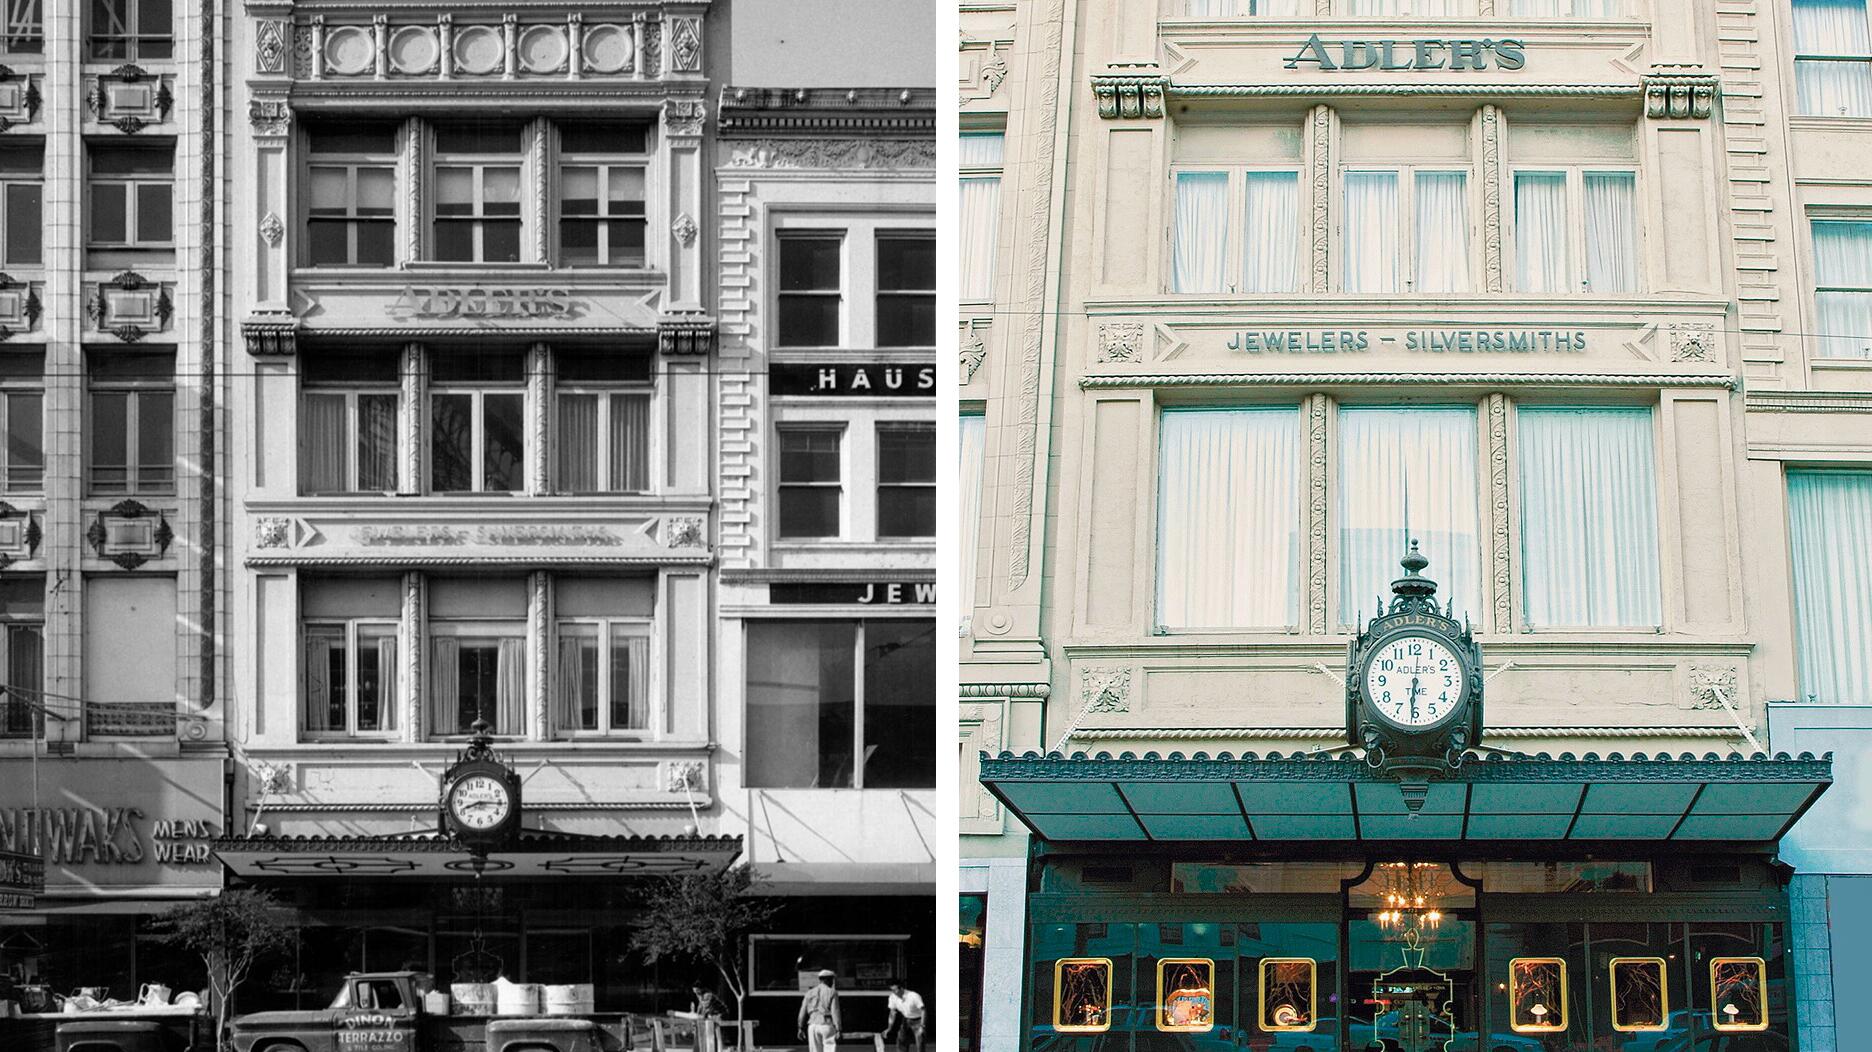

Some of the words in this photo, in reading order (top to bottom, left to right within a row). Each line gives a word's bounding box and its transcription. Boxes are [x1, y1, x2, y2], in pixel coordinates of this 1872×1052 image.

[1283, 32, 1526, 71] ADLER'S
[384, 284, 569, 316] ADLER'S
[1227, 331, 1369, 352] JEWELERS
[1404, 331, 1587, 352] SILVERSMITHS
[857, 583, 936, 604] JEW
[1383, 615, 1449, 630] ADLER'S
[1393, 648, 1404, 660] 11
[1407, 643, 1422, 656] 12
[1429, 648, 1434, 660] 1
[1380, 659, 1394, 672] 10
[1396, 665, 1436, 674] ADLER'S
[1439, 659, 1449, 672] 2
[1378, 675, 1387, 687] 9
[1444, 675, 1452, 687] 3
[1382, 690, 1391, 703] 8
[1405, 687, 1428, 696] TME
[1438, 691, 1448, 703] 4
[1395, 702, 1403, 715] 7
[1411, 706, 1420, 719] 6
[1428, 702, 1436, 715] 5
[154, 819, 209, 838] MENS
[153, 842, 210, 863] WEAR
[338, 1031, 404, 1043] TERRAZZO
